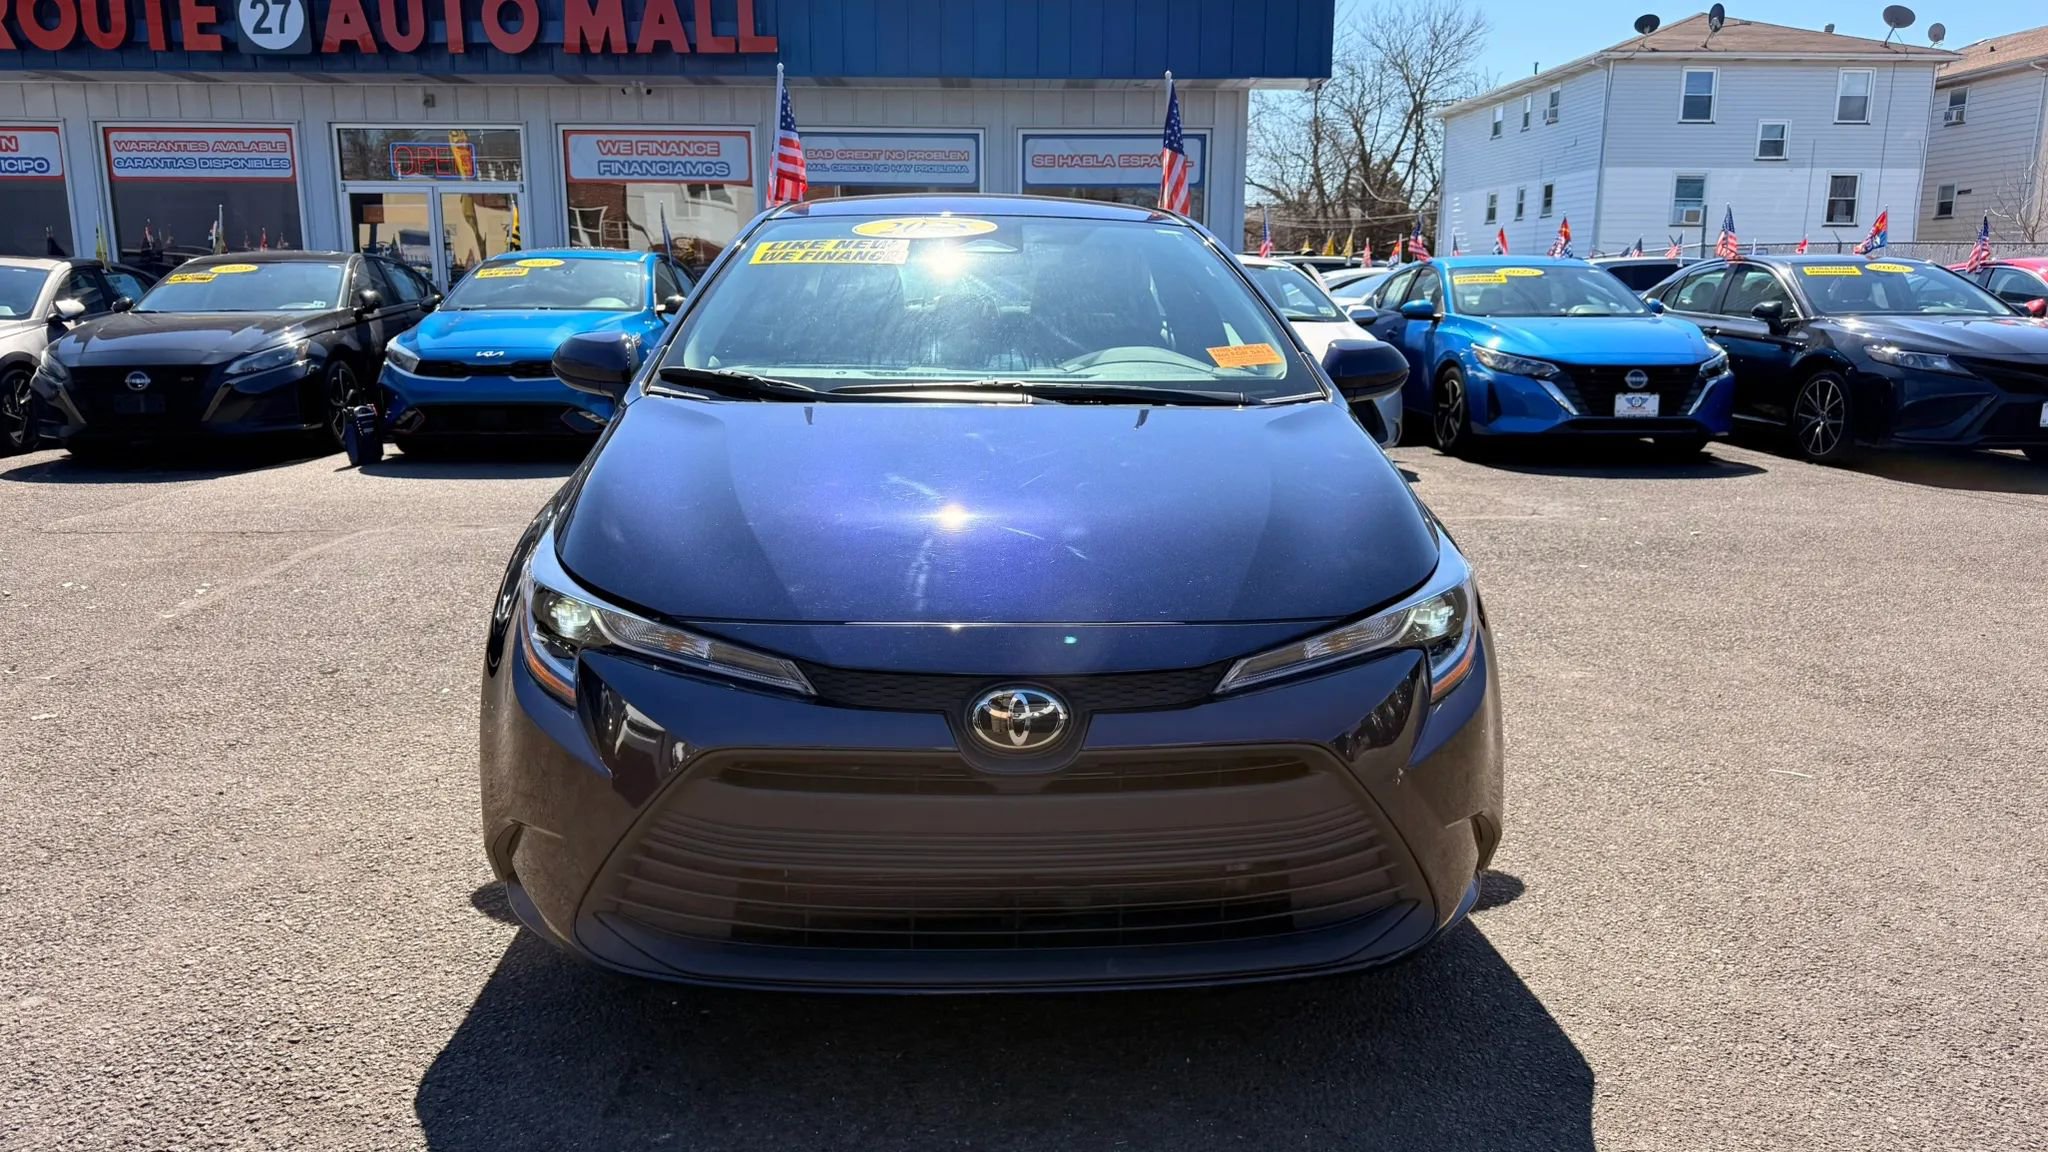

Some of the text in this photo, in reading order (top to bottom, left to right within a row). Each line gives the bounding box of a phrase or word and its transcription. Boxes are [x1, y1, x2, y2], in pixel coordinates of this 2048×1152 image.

[0, 0, 778, 54] OUTE 27 AUTO MALL
[114, 140, 287, 153] WARRANTIES AVAILABLE
[597, 140, 720, 157] WE FINANCE
[806, 149, 969, 162] BAD CREDIT NO PROBLEM
[1032, 154, 1055, 167] SE
[1057, 154, 1115, 168] HABLA
[114, 157, 291, 169] GARANTIAS DISPONIBLES
[598, 160, 731, 177] FINANCIAMOS
[831, 163, 873, 173] CREDITO
[874, 164, 890, 173] NO
[891, 164, 913, 174] HAY
[914, 164, 969, 174] PROBLEMA
[766, 240, 827, 251] LIKE
[760, 251, 797, 262] WE
